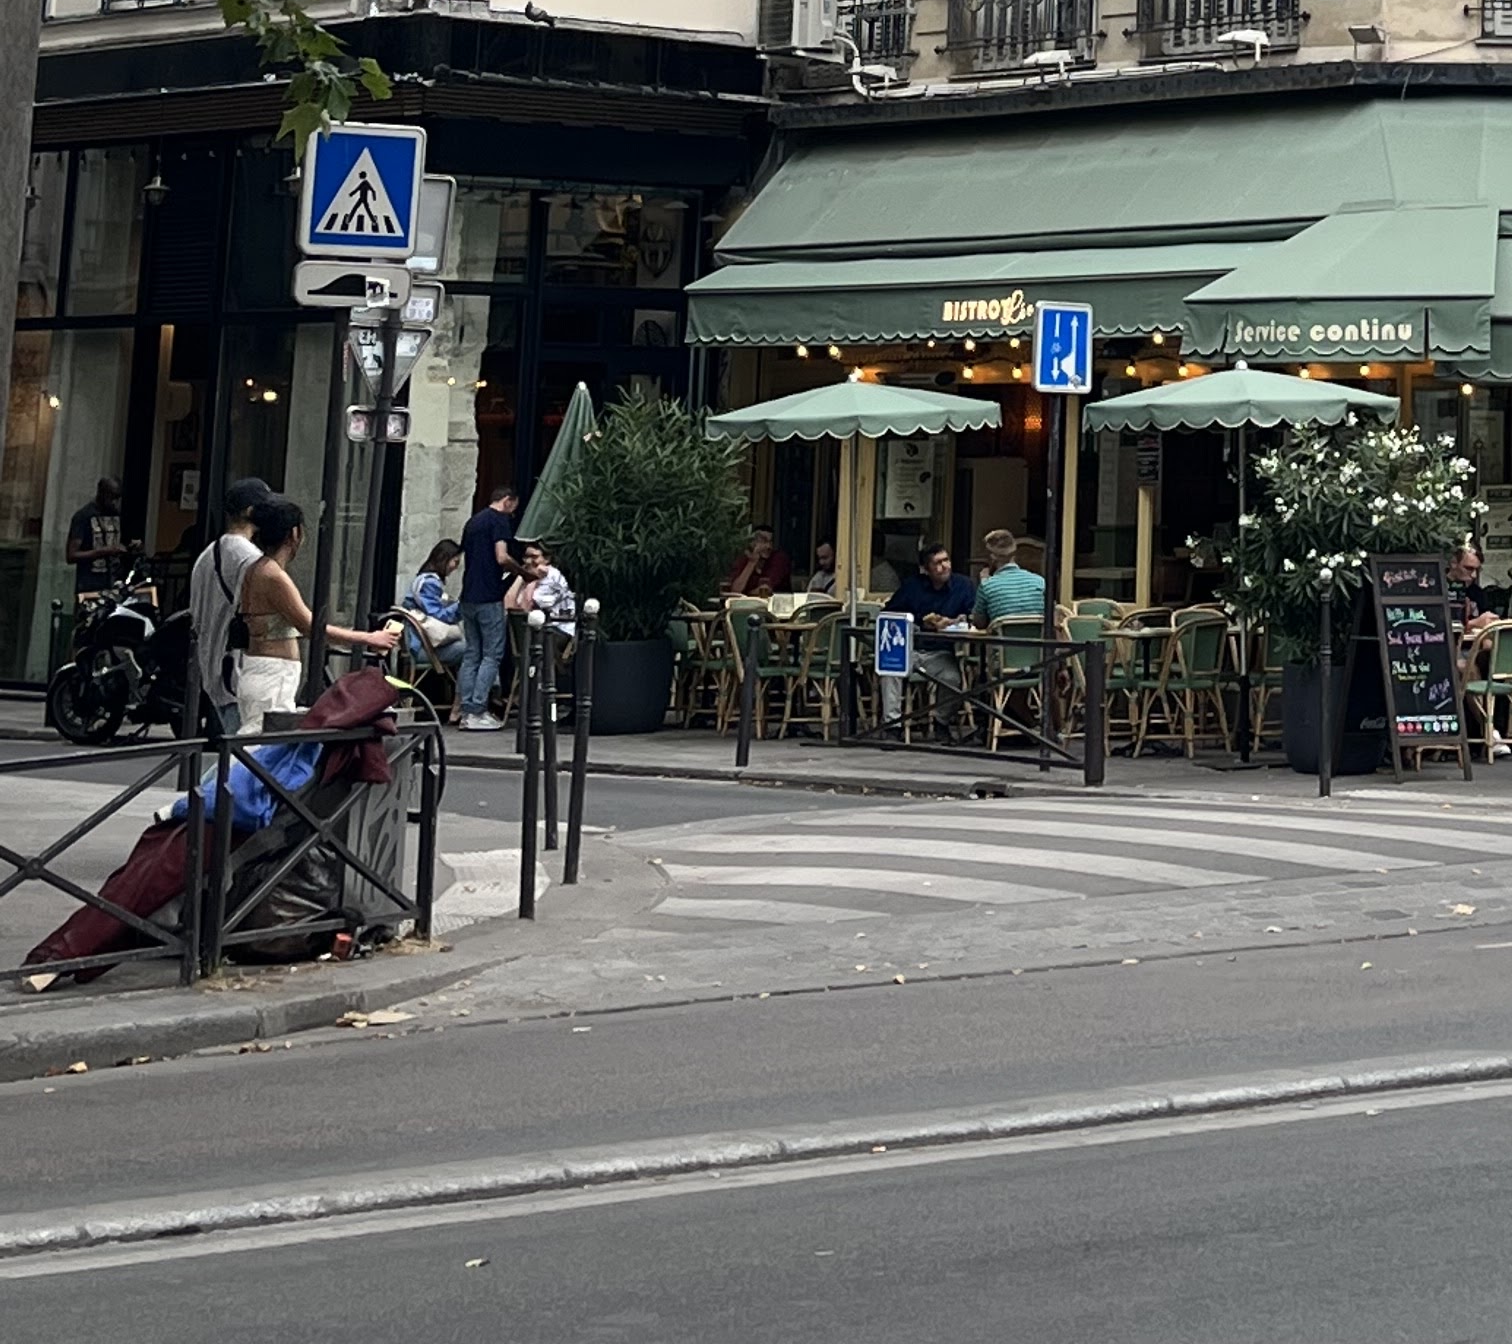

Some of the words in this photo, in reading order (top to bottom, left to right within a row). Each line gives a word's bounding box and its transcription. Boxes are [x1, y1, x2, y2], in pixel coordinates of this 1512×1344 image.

[942, 298, 1010, 322] BISTROT
[1234, 319, 1301, 343] Service
[1309, 318, 1413, 342] continu
